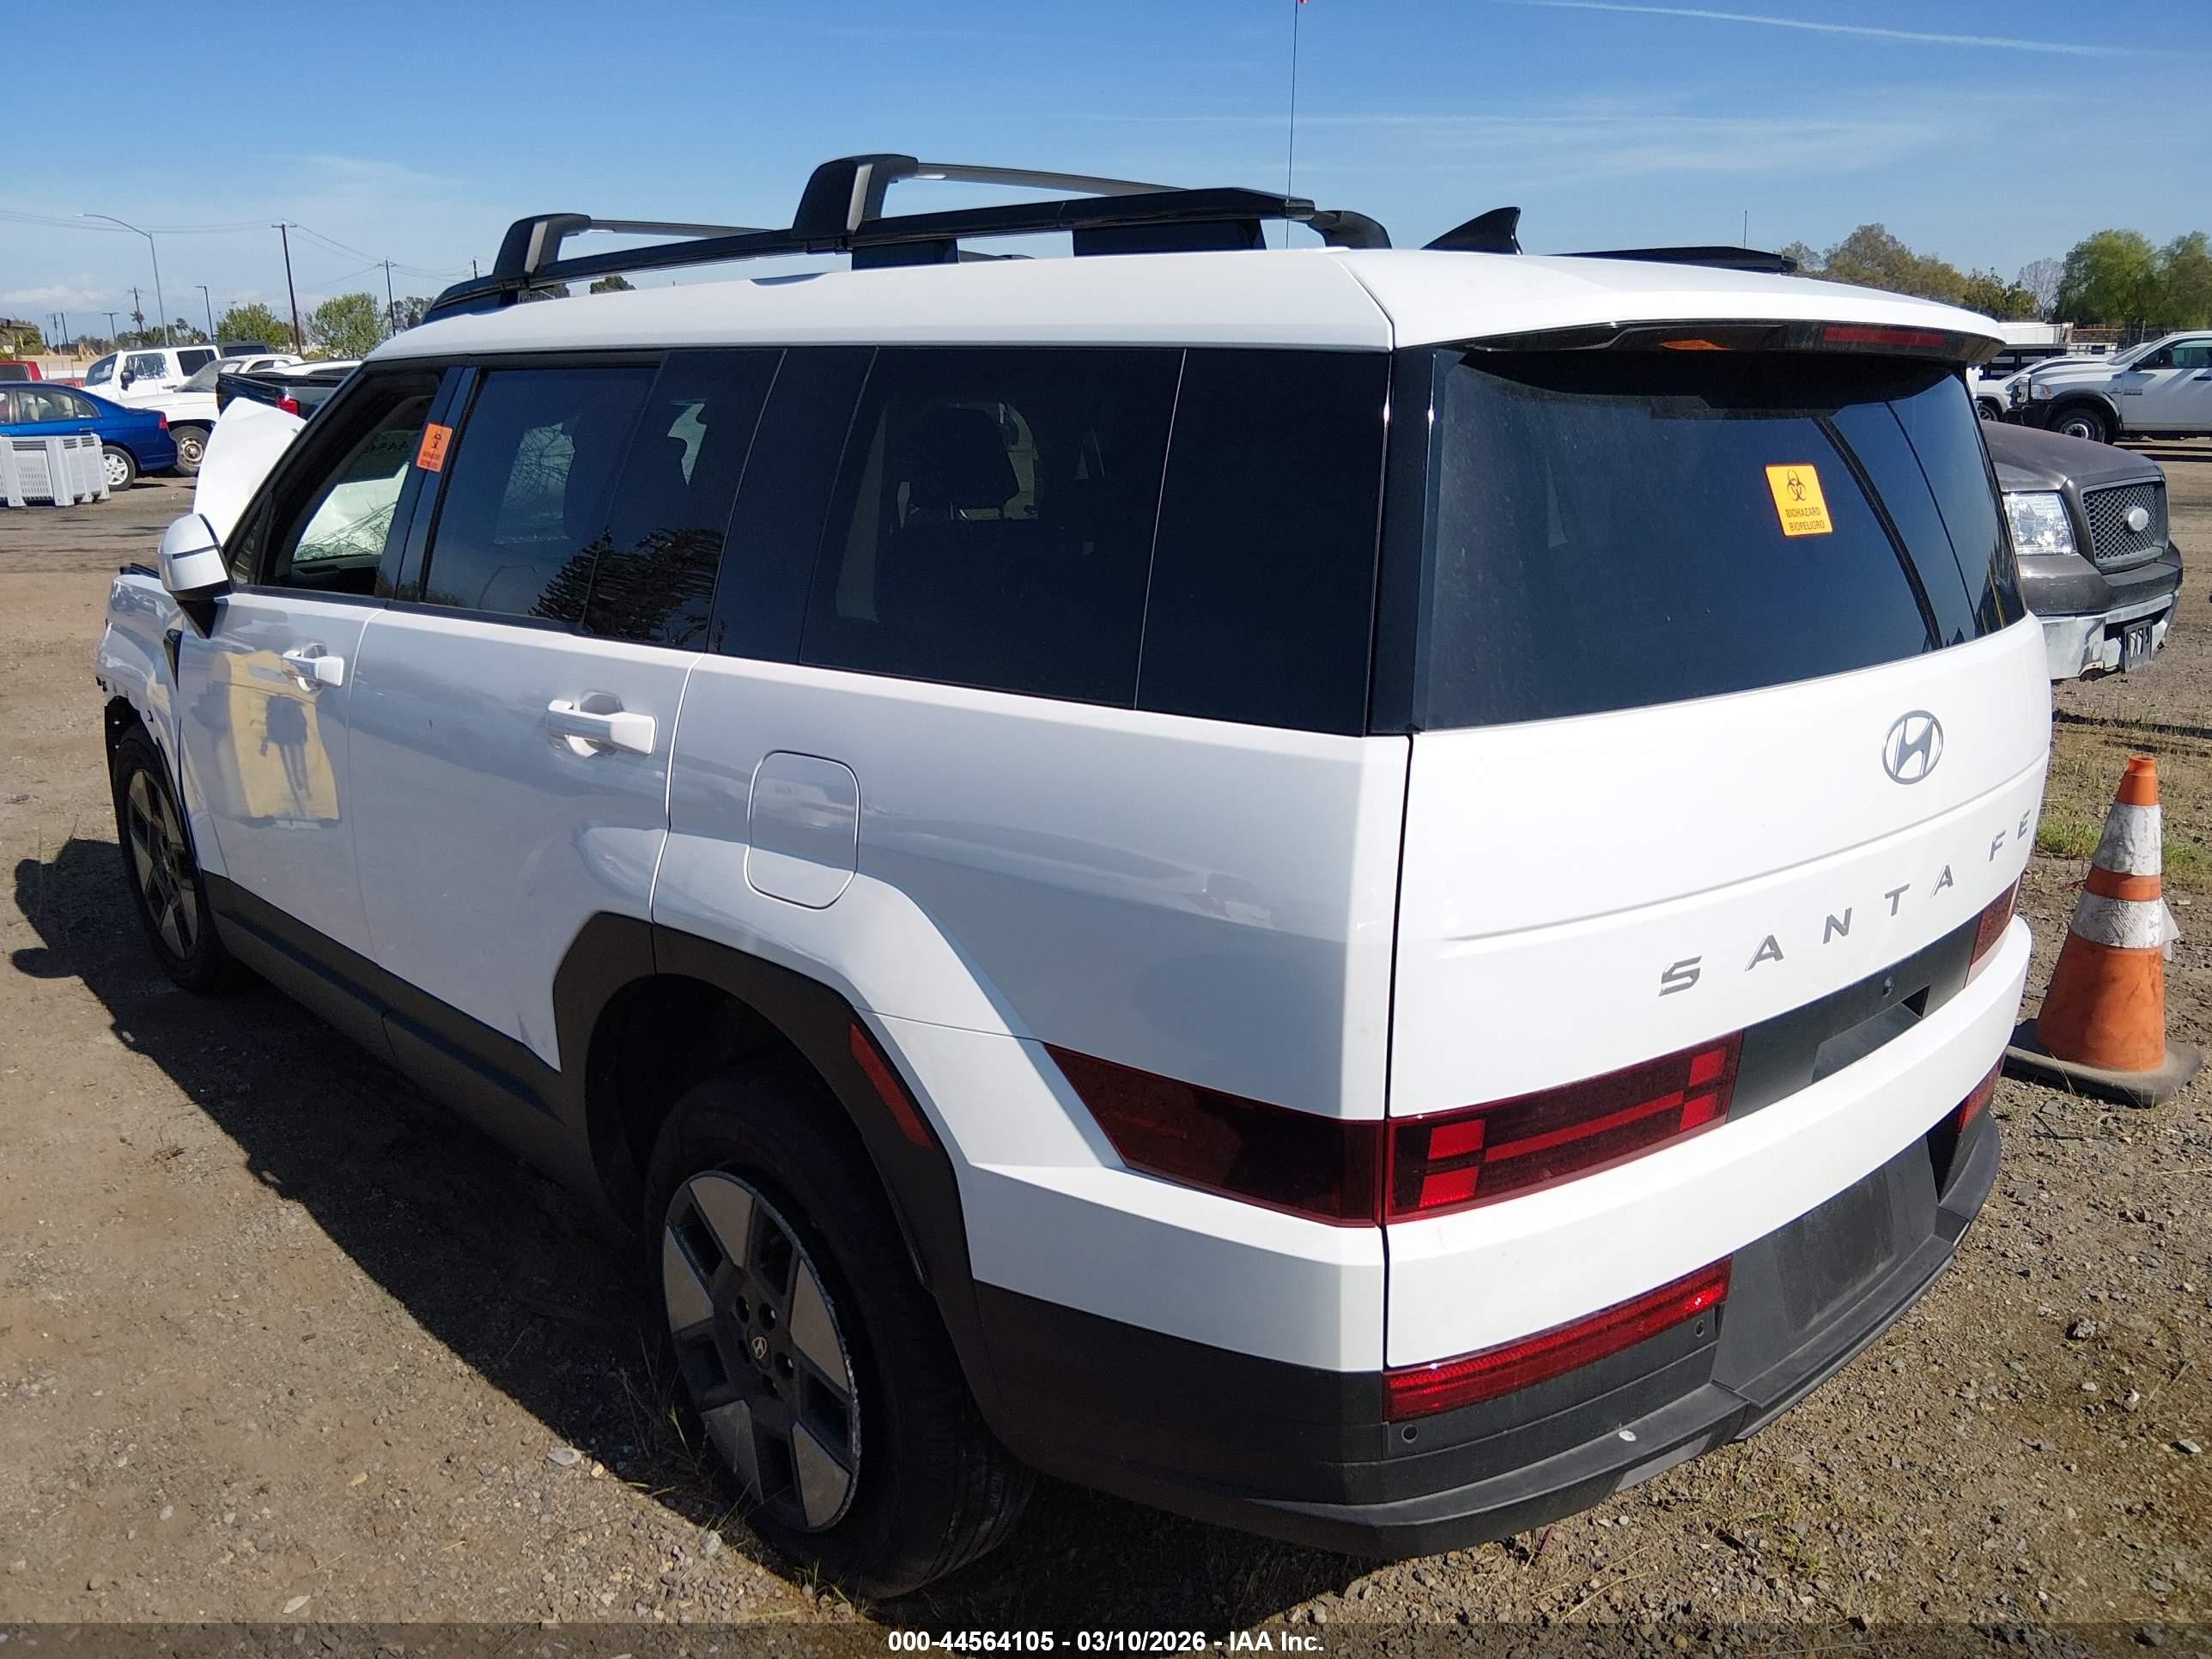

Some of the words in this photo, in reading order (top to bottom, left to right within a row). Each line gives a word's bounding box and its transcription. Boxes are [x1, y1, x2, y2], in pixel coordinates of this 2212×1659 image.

[1785, 507, 1820, 518] BIOHAZARD
[1789, 520, 1825, 532] BIOPELIGRO
[1658, 864, 1954, 997] SANTA
[1988, 809, 2031, 862] FE
